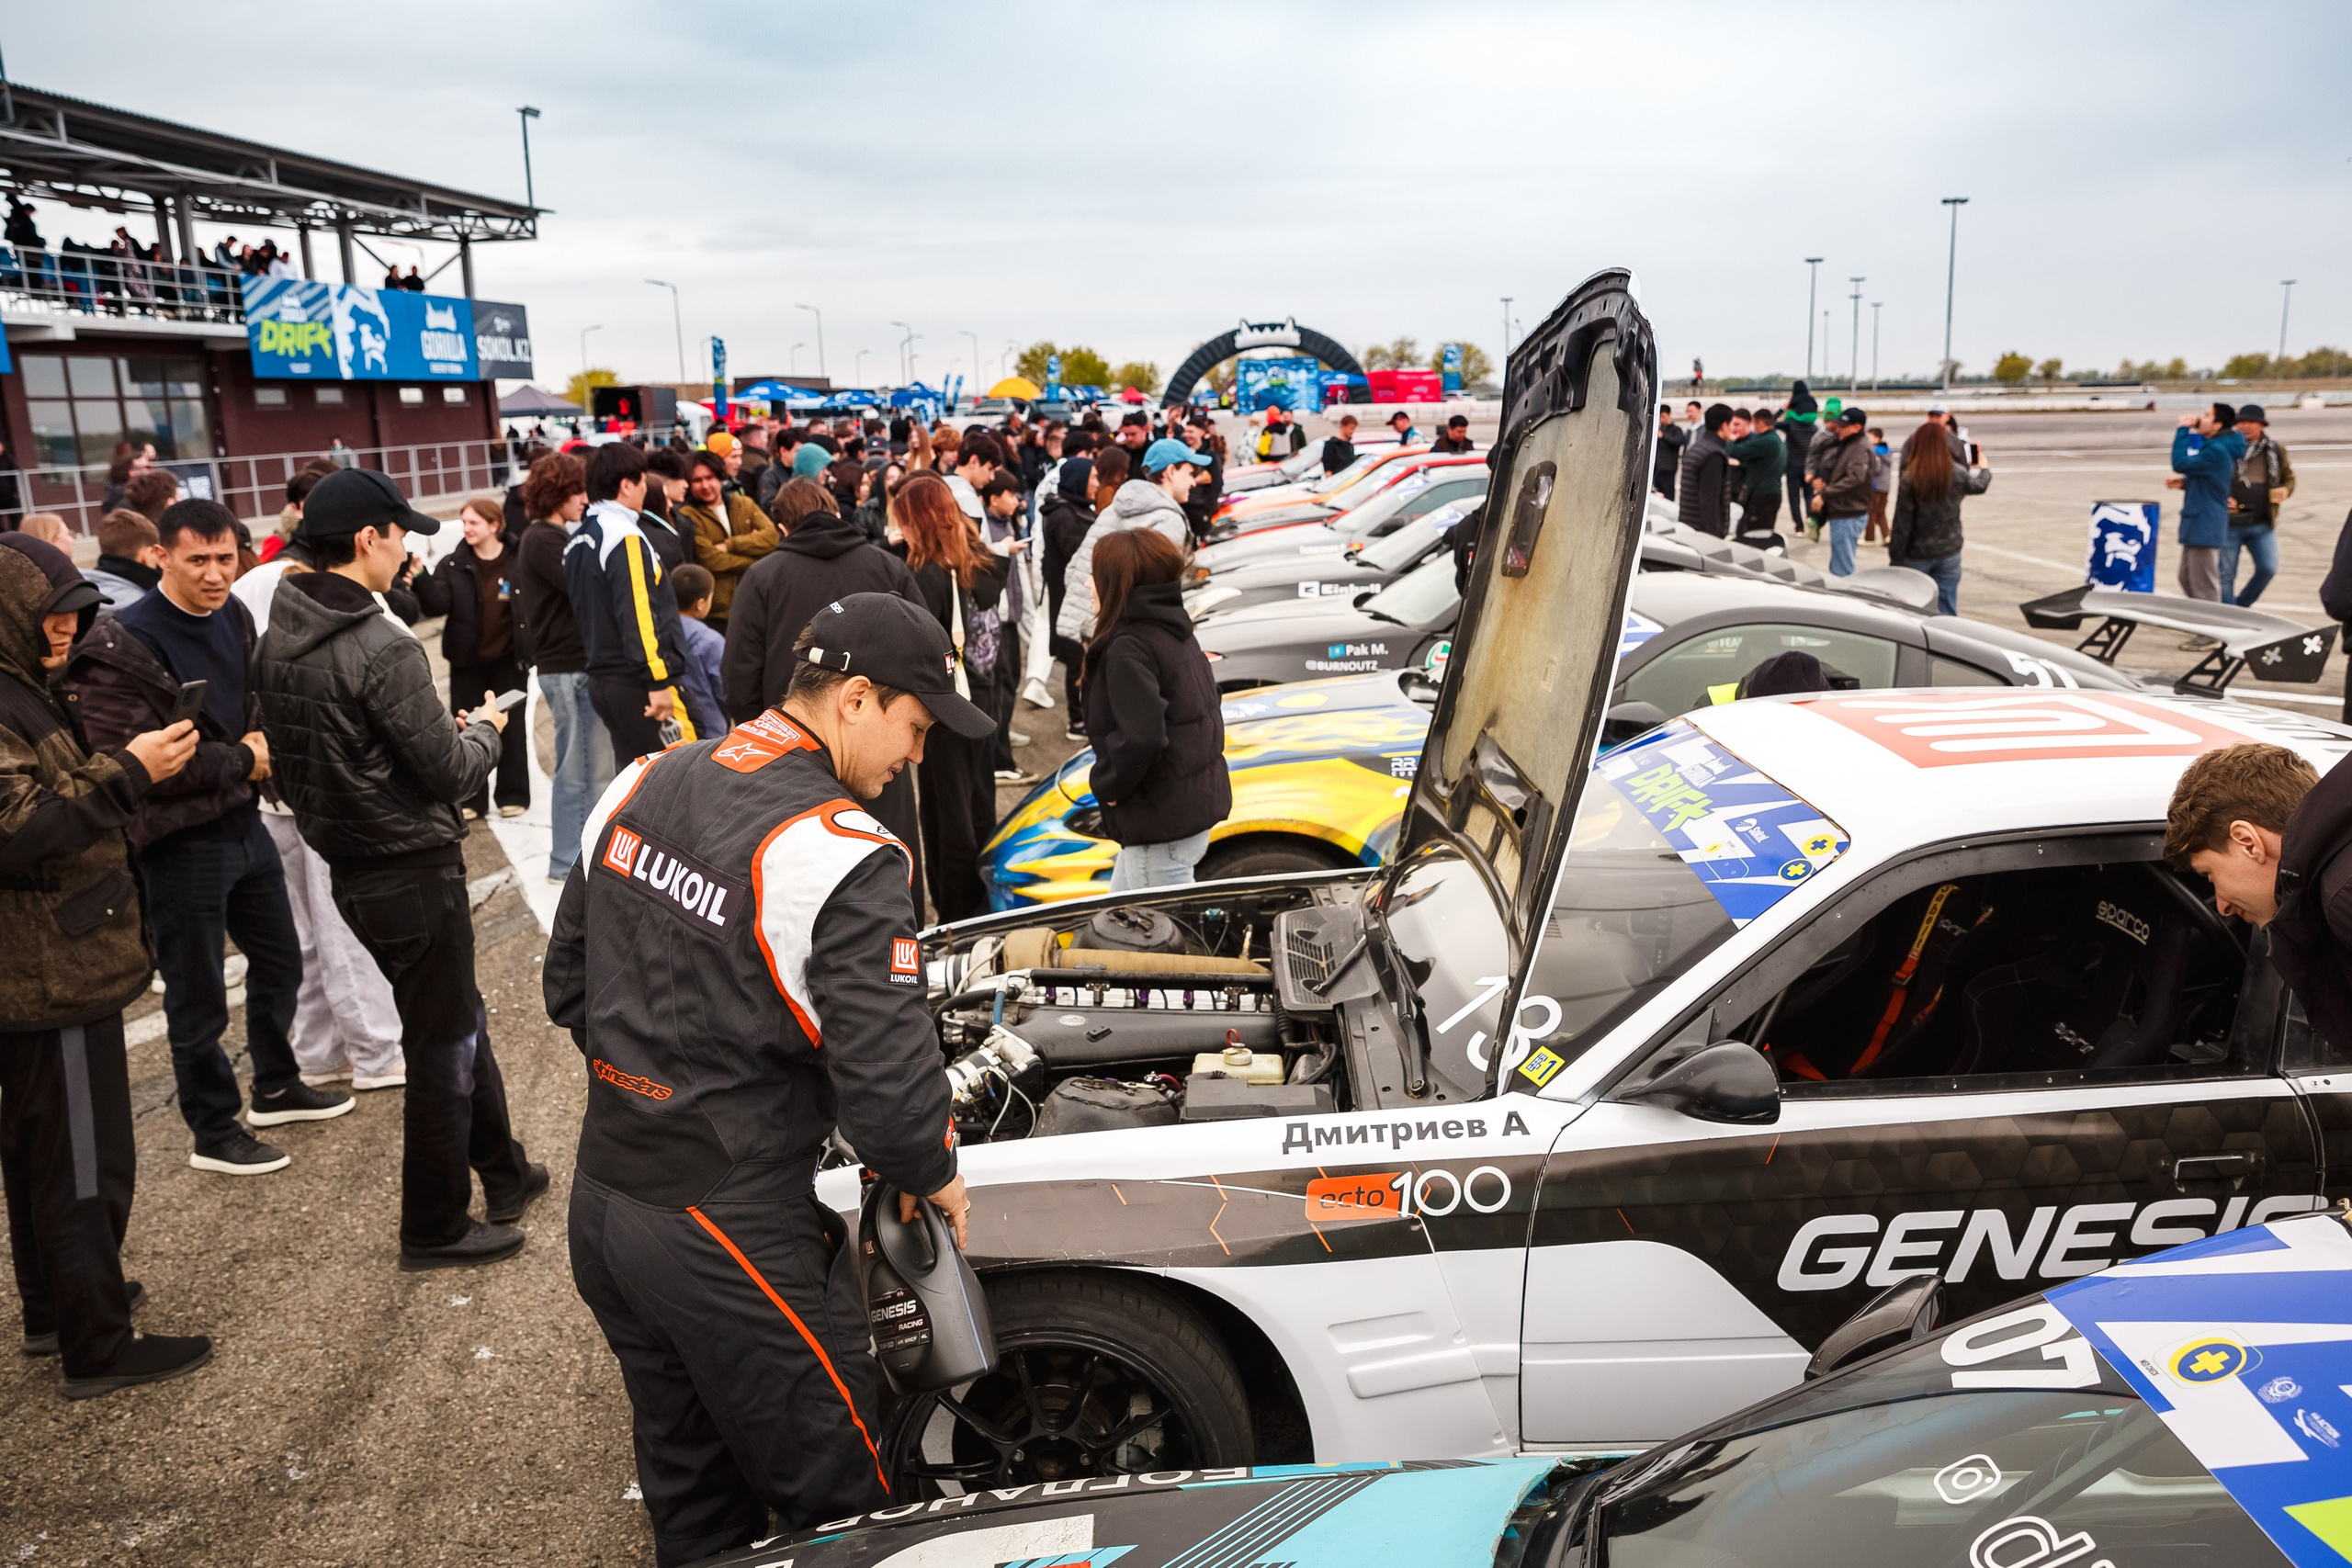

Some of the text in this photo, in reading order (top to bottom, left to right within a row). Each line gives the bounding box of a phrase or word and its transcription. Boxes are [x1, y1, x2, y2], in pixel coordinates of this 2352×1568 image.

[259, 319, 333, 359] DRIFT
[1345, 643, 1389, 656] Pak M.
[1624, 762, 1713, 833] DRIFT
[633, 843, 728, 927] LUKOIL
[2098, 900, 2150, 941] sparco
[890, 974, 918, 984] LUKOIL
[593, 1059, 673, 1100] alpinestars
[1283, 1111, 1531, 1155] Дмитриев А
[1319, 1166, 1511, 1218] ecto 100
[1778, 1195, 2329, 1291] GENES
[870, 1300, 917, 1323] GENESIS
[899, 1318, 923, 1331] RACING
